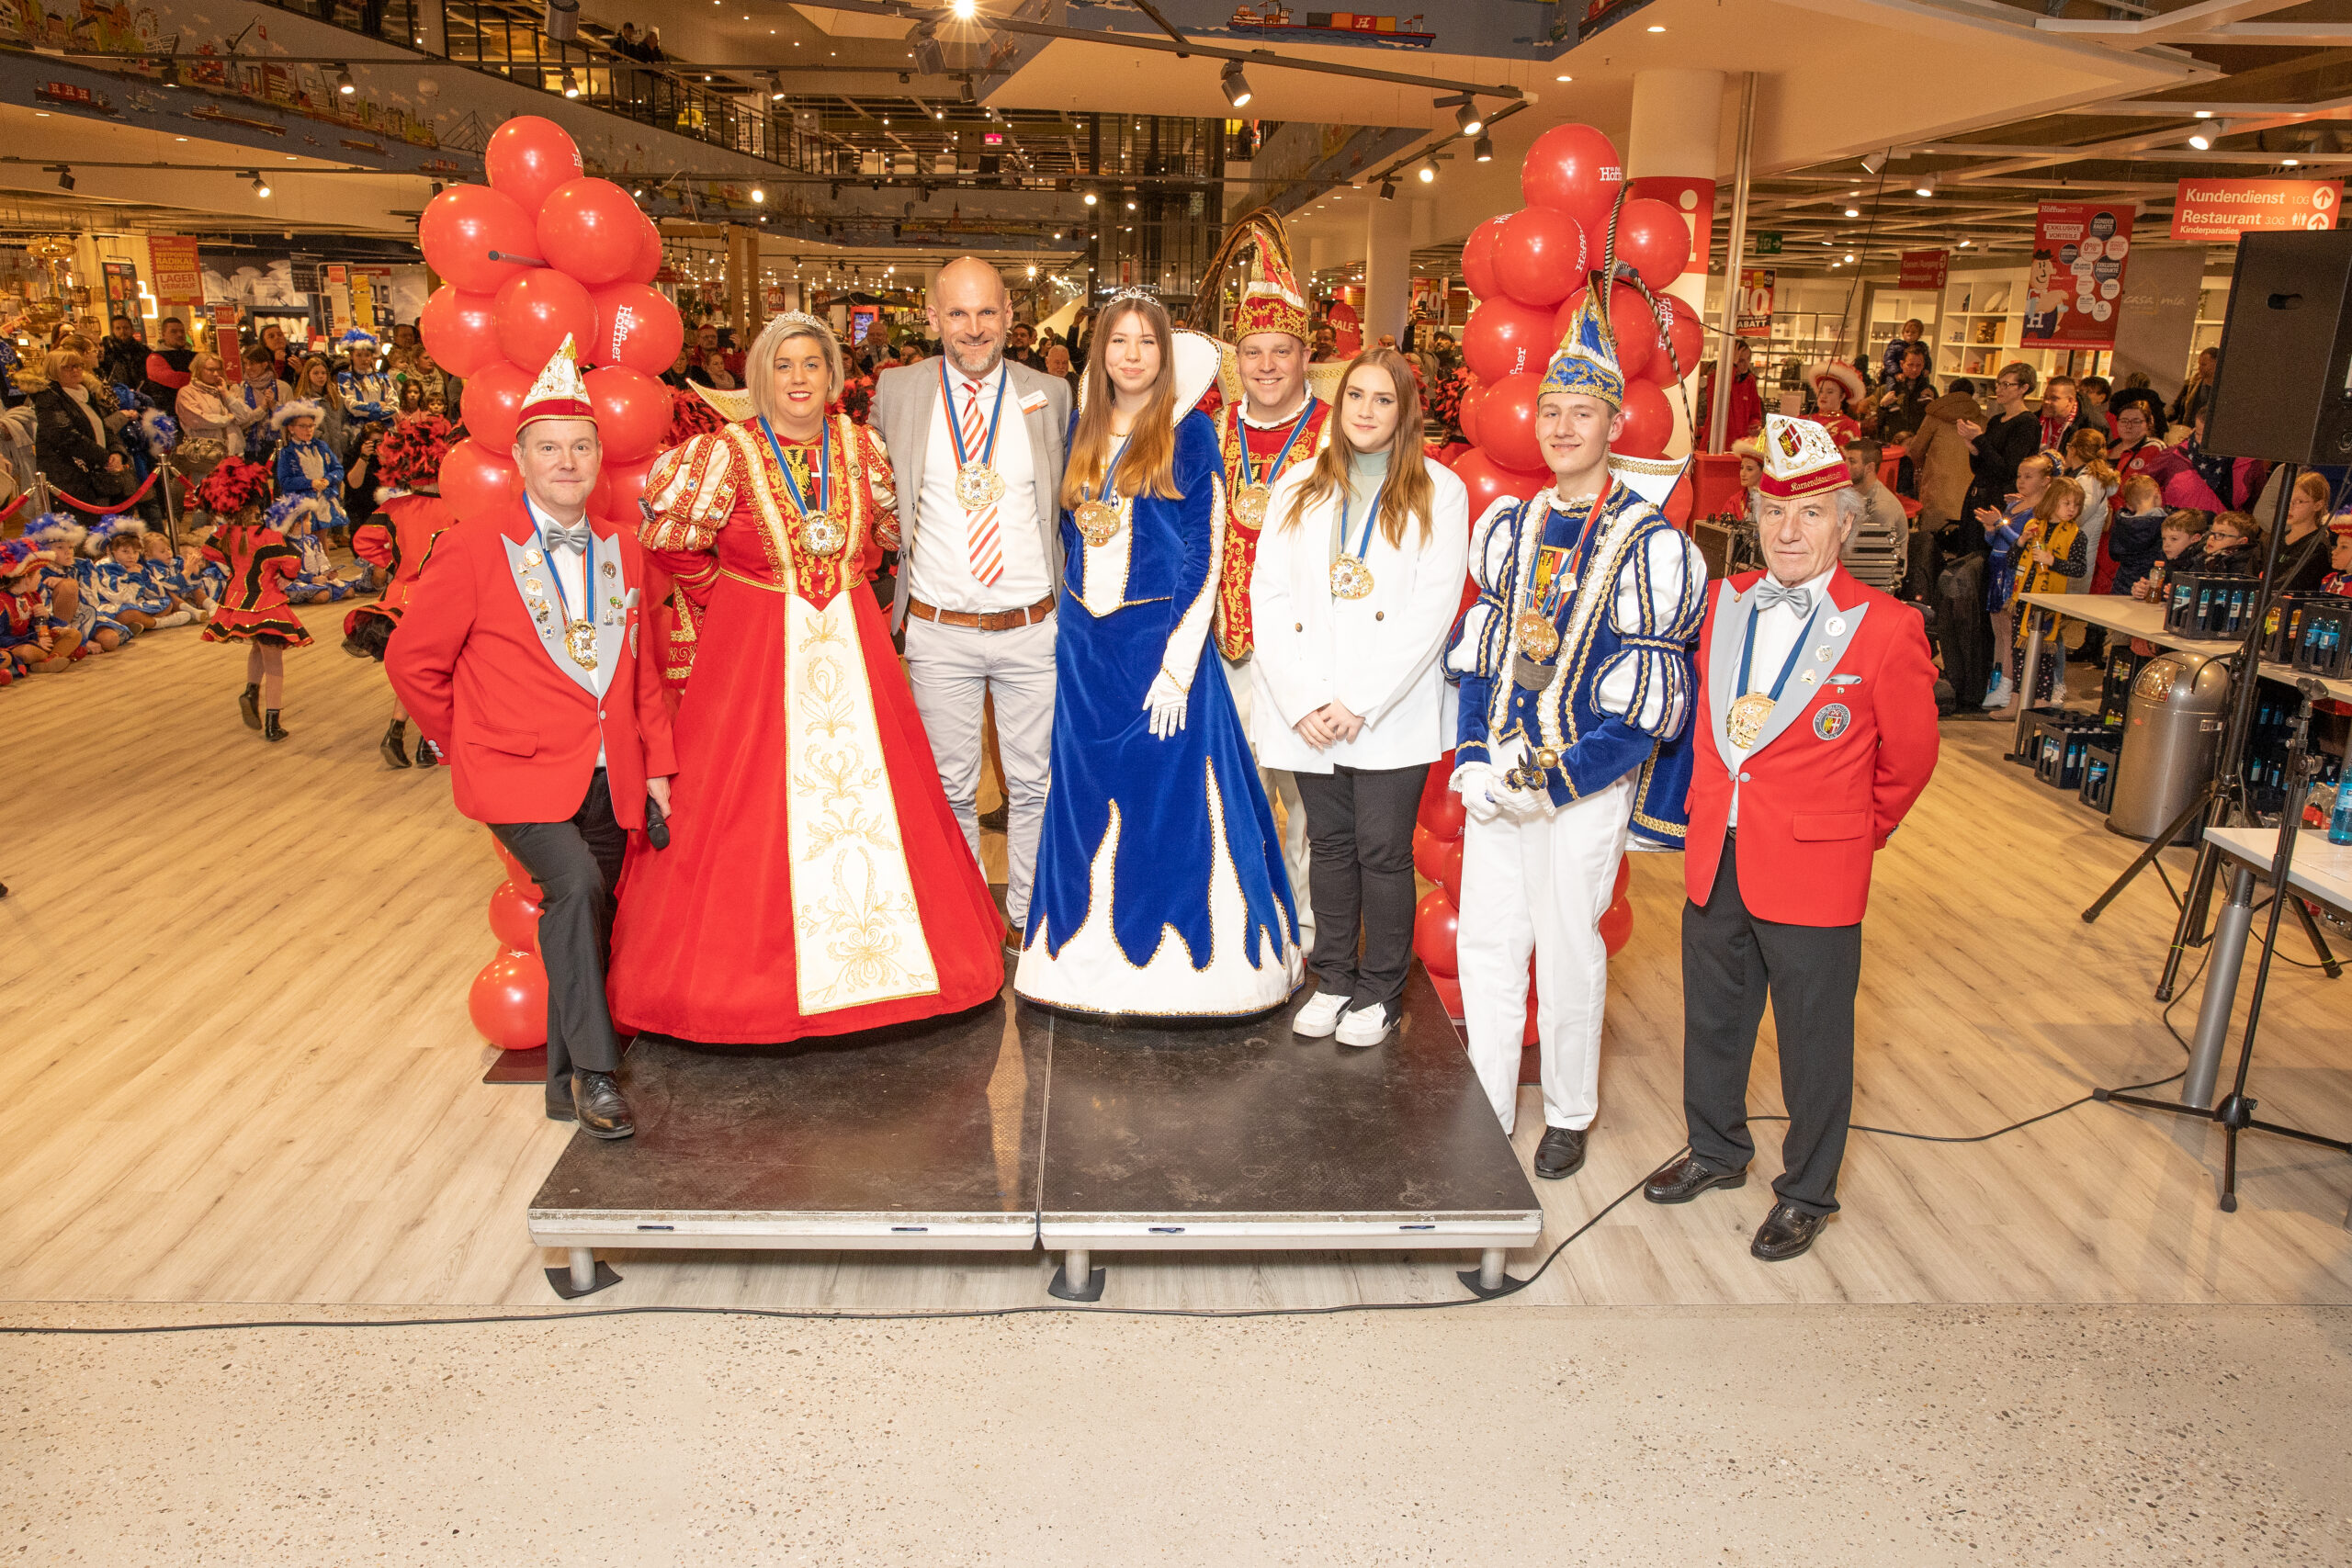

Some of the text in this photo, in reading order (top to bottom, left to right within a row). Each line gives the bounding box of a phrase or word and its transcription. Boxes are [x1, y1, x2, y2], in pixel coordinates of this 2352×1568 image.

[2186, 188, 2310, 205] Kundendienst 1.OG
[2181, 209, 2262, 225] Restaurant
[2179, 225, 2240, 235] Kinderparadies
[155, 257, 195, 265] RADIKAL
[160, 274, 196, 283] LAGER
[161, 282, 198, 290] VERKAUF
[769, 293, 784, 304] 40
[1414, 291, 1442, 311] 40
[1330, 319, 1355, 333] SALE
[1657, 297, 1674, 352] Höffr
[1736, 320, 1768, 329] ABATT
[2026, 311, 2045, 329] H
[612, 304, 633, 362] Höffner
[1509, 346, 1527, 375] fner
